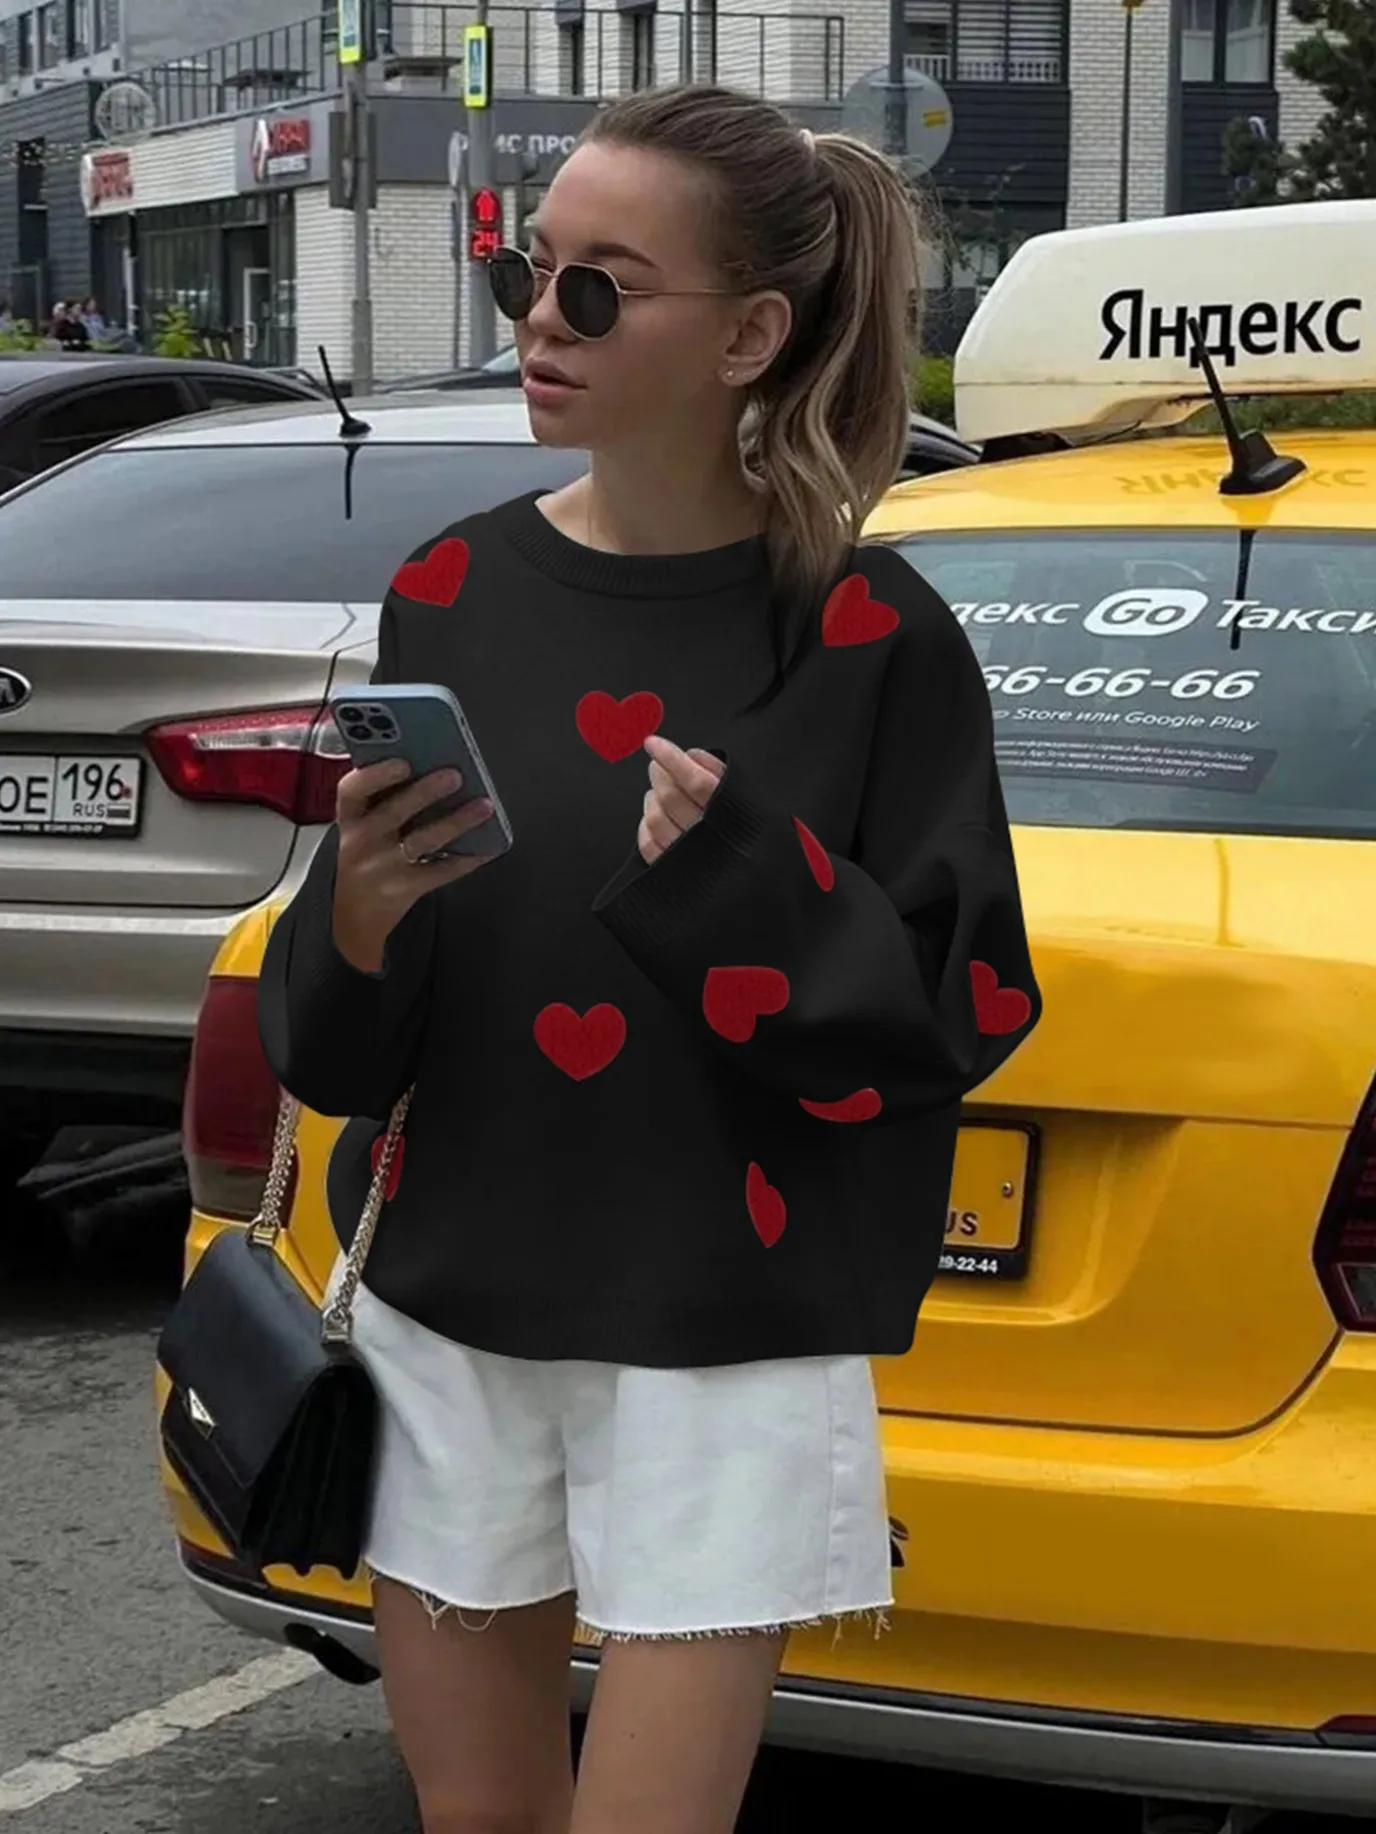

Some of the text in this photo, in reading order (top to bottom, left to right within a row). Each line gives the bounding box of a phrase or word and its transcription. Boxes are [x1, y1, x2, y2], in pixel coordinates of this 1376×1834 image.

[1099, 289, 1362, 367] Яндекс
[1013, 707, 1073, 722] Store
[1075, 711, 1120, 723] или
[1124, 711, 1206, 728] Google
[1209, 715, 1261, 733] Play
[61, 763, 125, 801] 196
[73, 803, 107, 818] RUS
